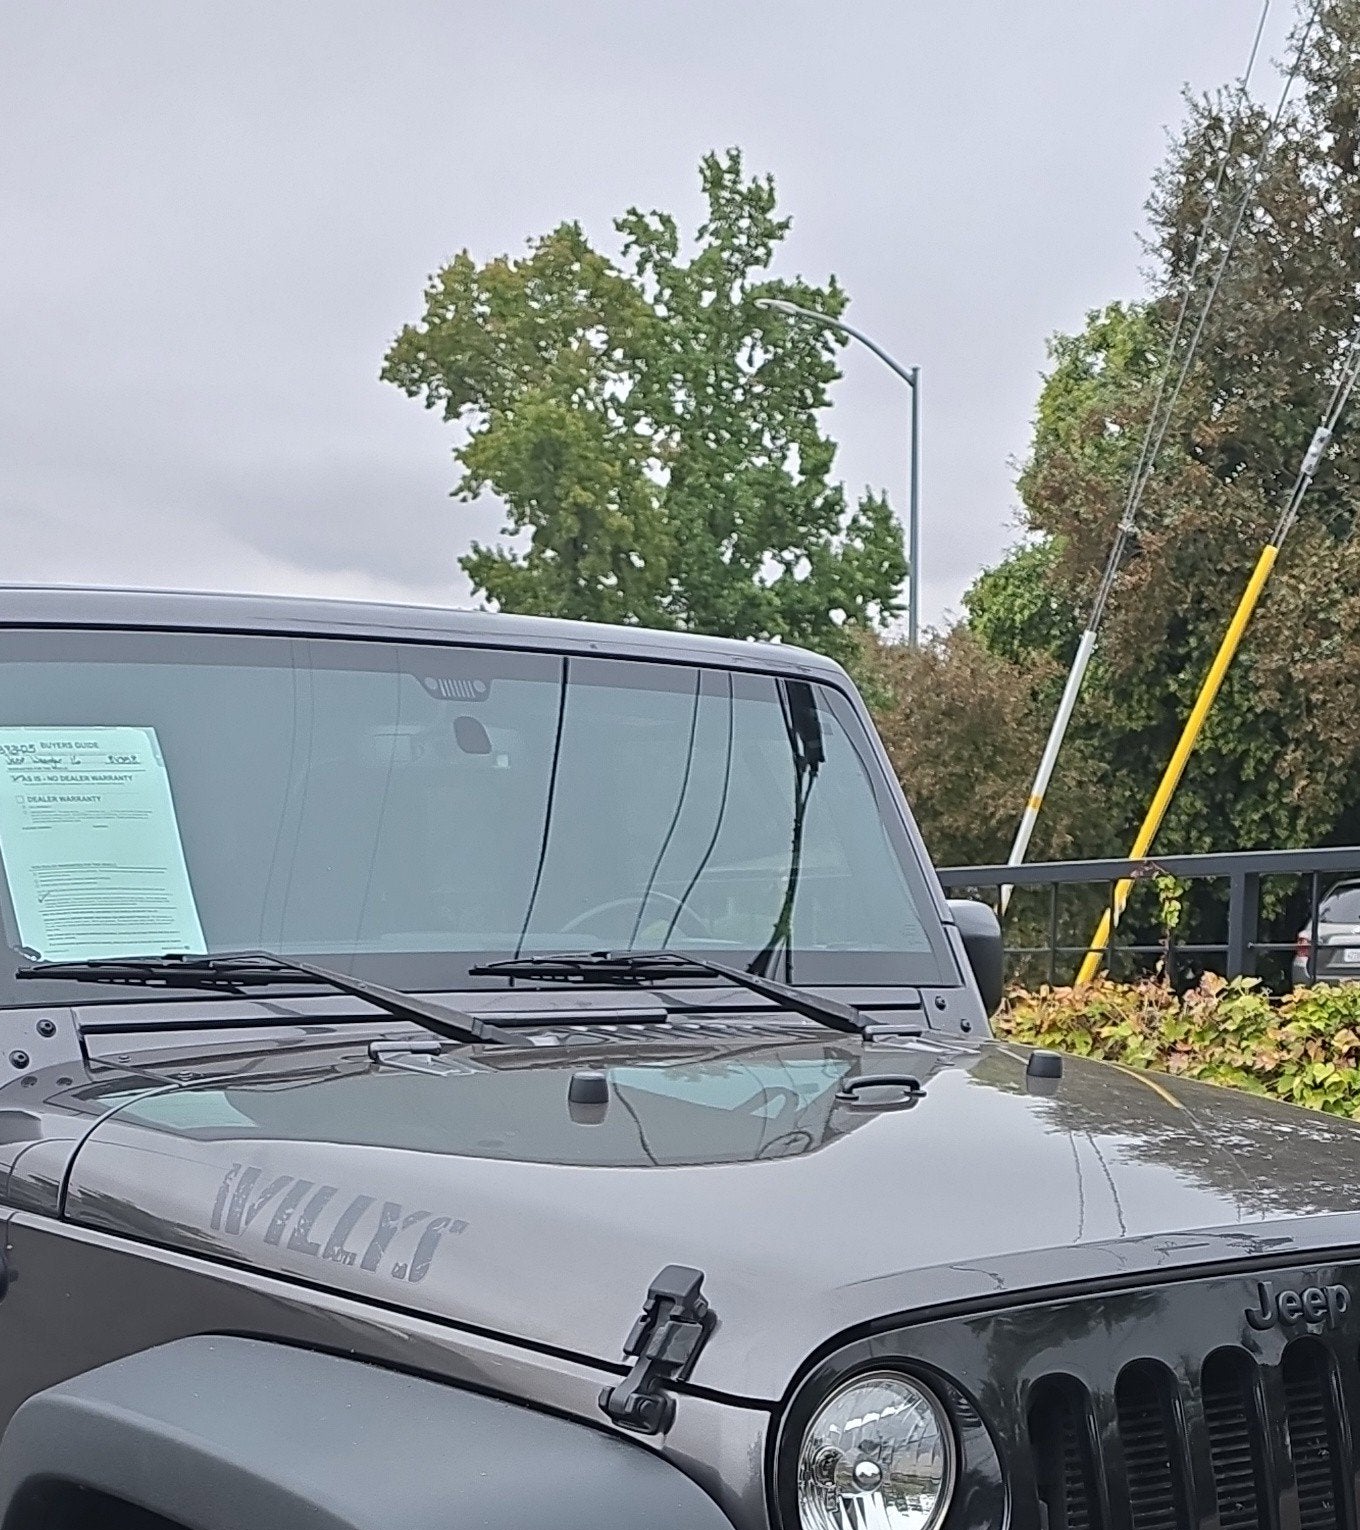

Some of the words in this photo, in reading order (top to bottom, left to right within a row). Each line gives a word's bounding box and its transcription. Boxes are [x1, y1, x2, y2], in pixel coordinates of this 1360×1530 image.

[59, 795, 102, 803] WARRANTY
[210, 1162, 470, 1283] WILLYS
[1244, 1281, 1351, 1331] Jeep
